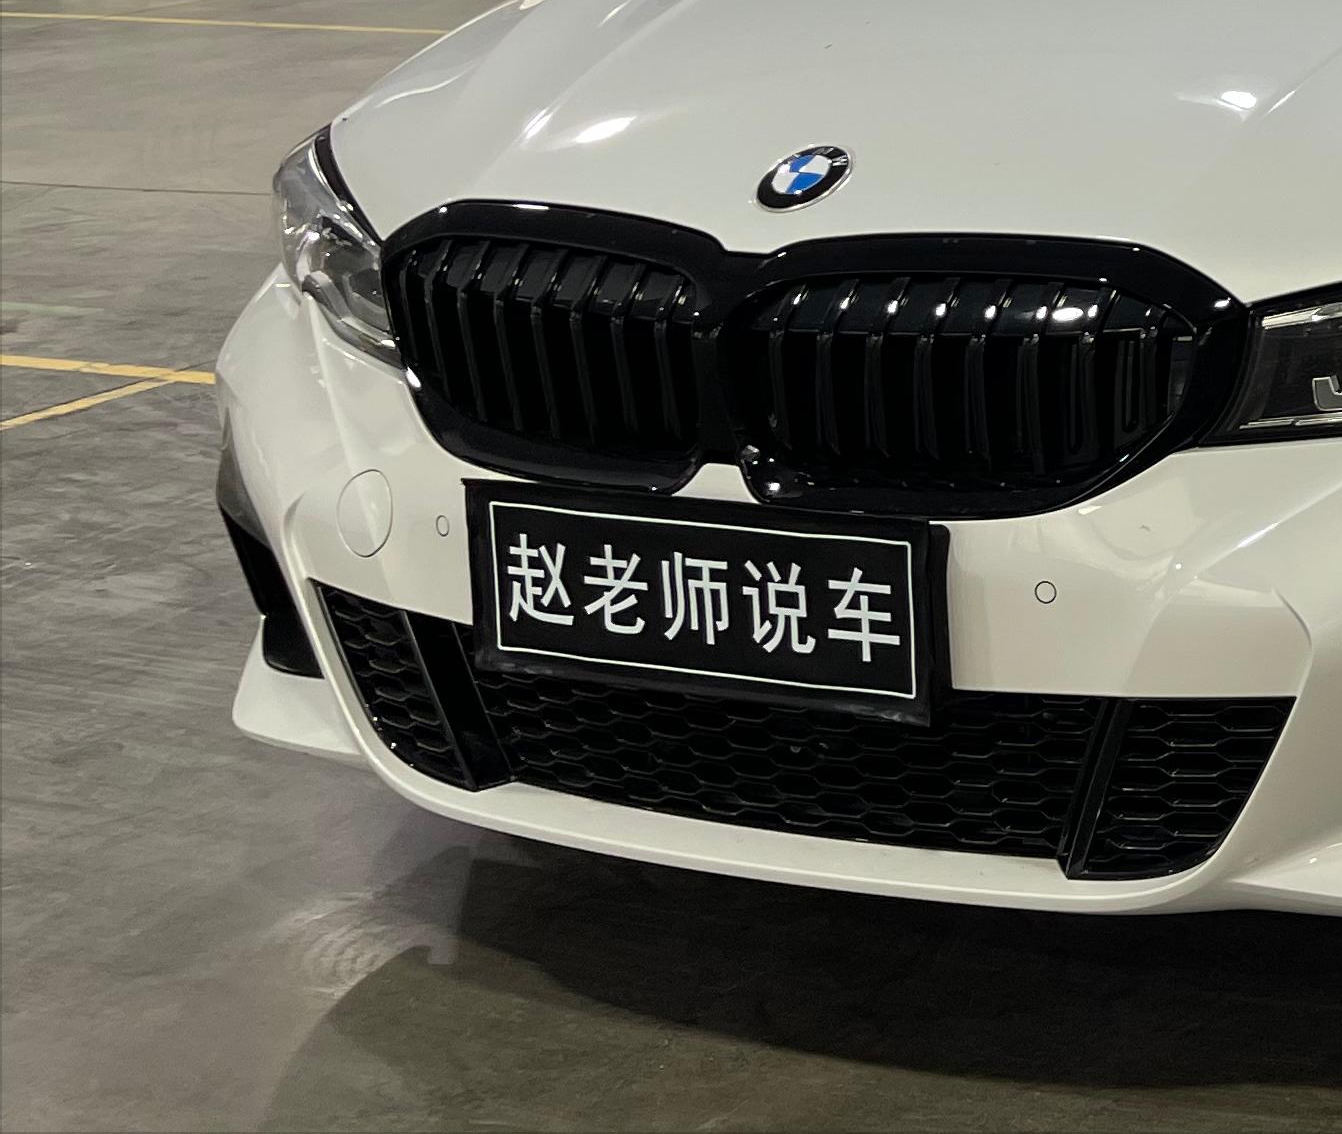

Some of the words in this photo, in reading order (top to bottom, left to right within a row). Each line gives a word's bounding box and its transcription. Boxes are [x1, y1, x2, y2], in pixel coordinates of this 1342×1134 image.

[507, 533, 900, 663] 赵老师说车
